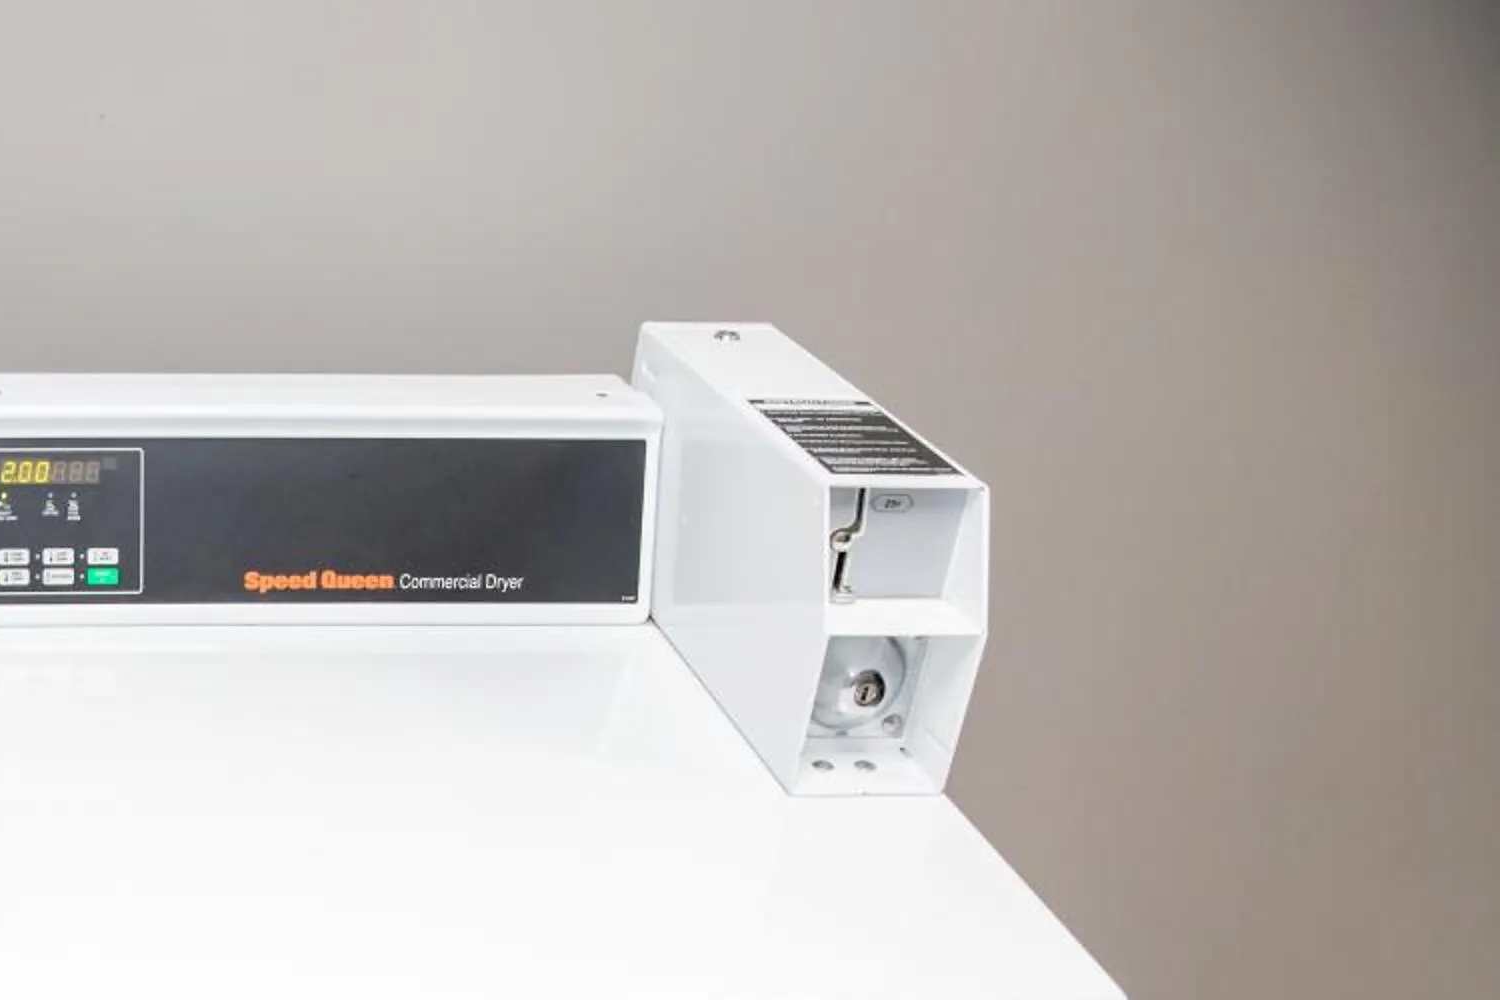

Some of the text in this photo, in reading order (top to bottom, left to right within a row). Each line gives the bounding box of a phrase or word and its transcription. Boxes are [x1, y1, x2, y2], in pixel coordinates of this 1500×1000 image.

[243, 570, 524, 593] Speed Queen Commercial Dryer
